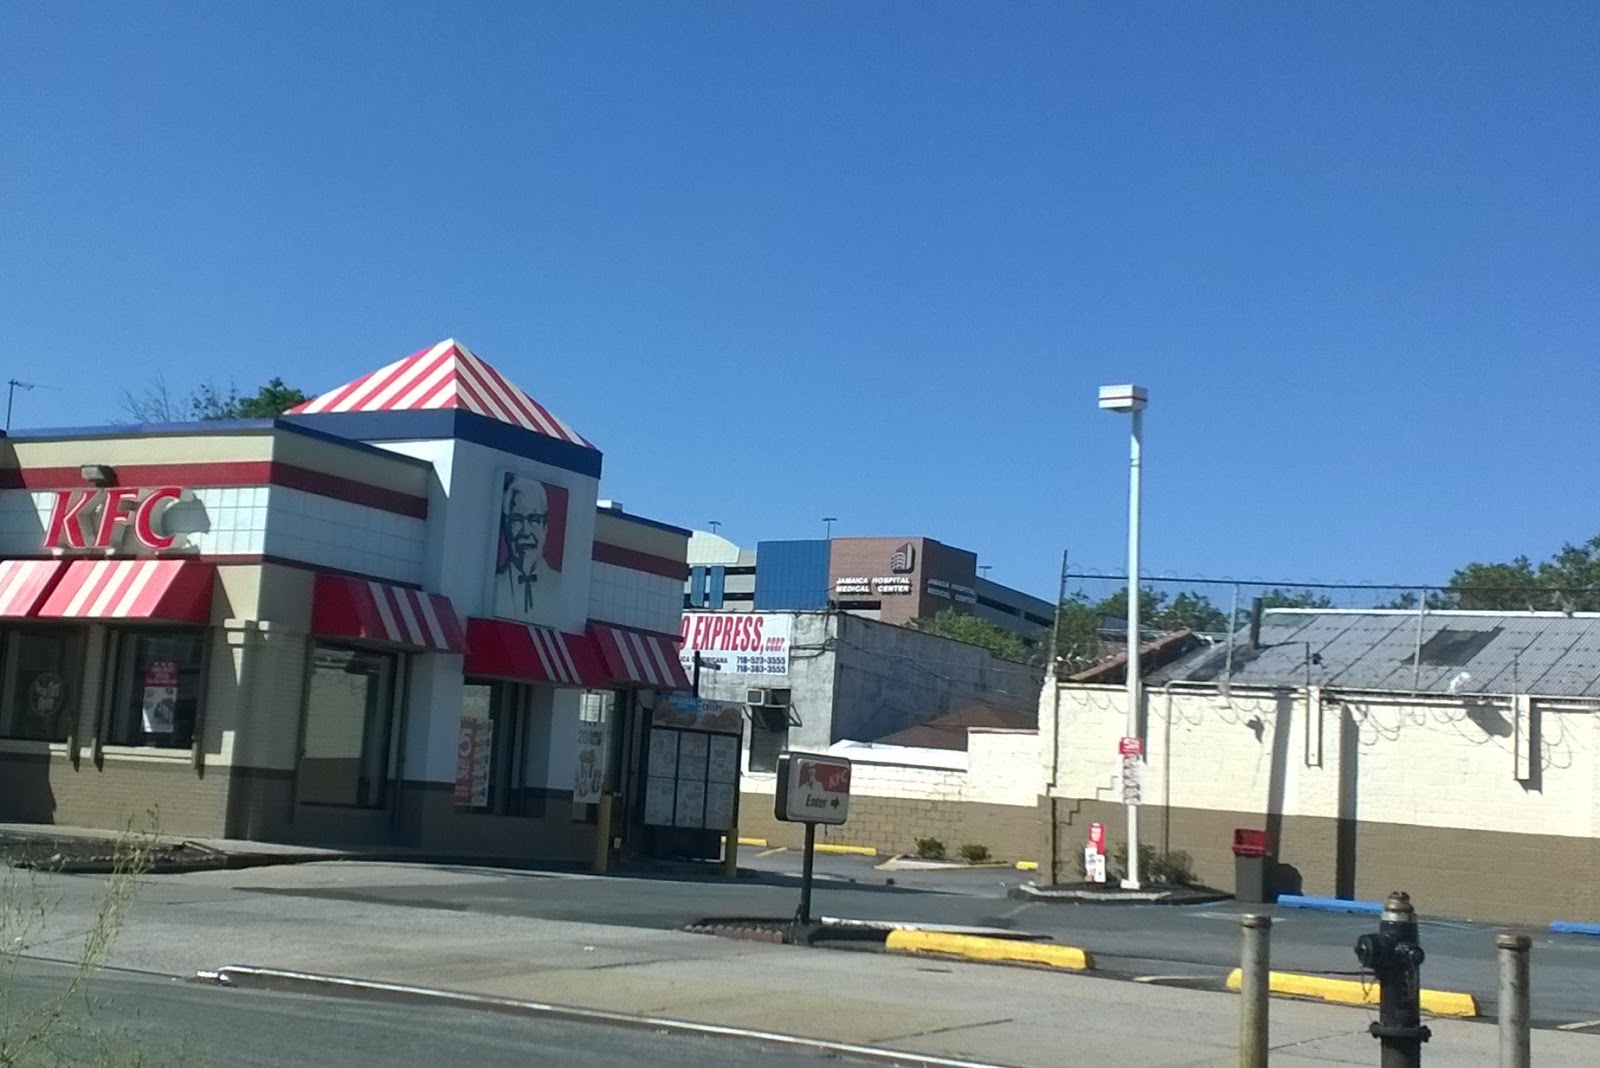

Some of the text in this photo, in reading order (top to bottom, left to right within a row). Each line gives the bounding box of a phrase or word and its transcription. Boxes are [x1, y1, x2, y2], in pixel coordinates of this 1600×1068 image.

[42, 485, 182, 548] KFC
[836, 576, 910, 584] JAMAICA HOSPITAL
[736, 655, 786, 665] 718-523-3555
[736, 664, 786, 673] 718-383-3555
[829, 769, 848, 788] KFC
[805, 794, 828, 809] Enter
